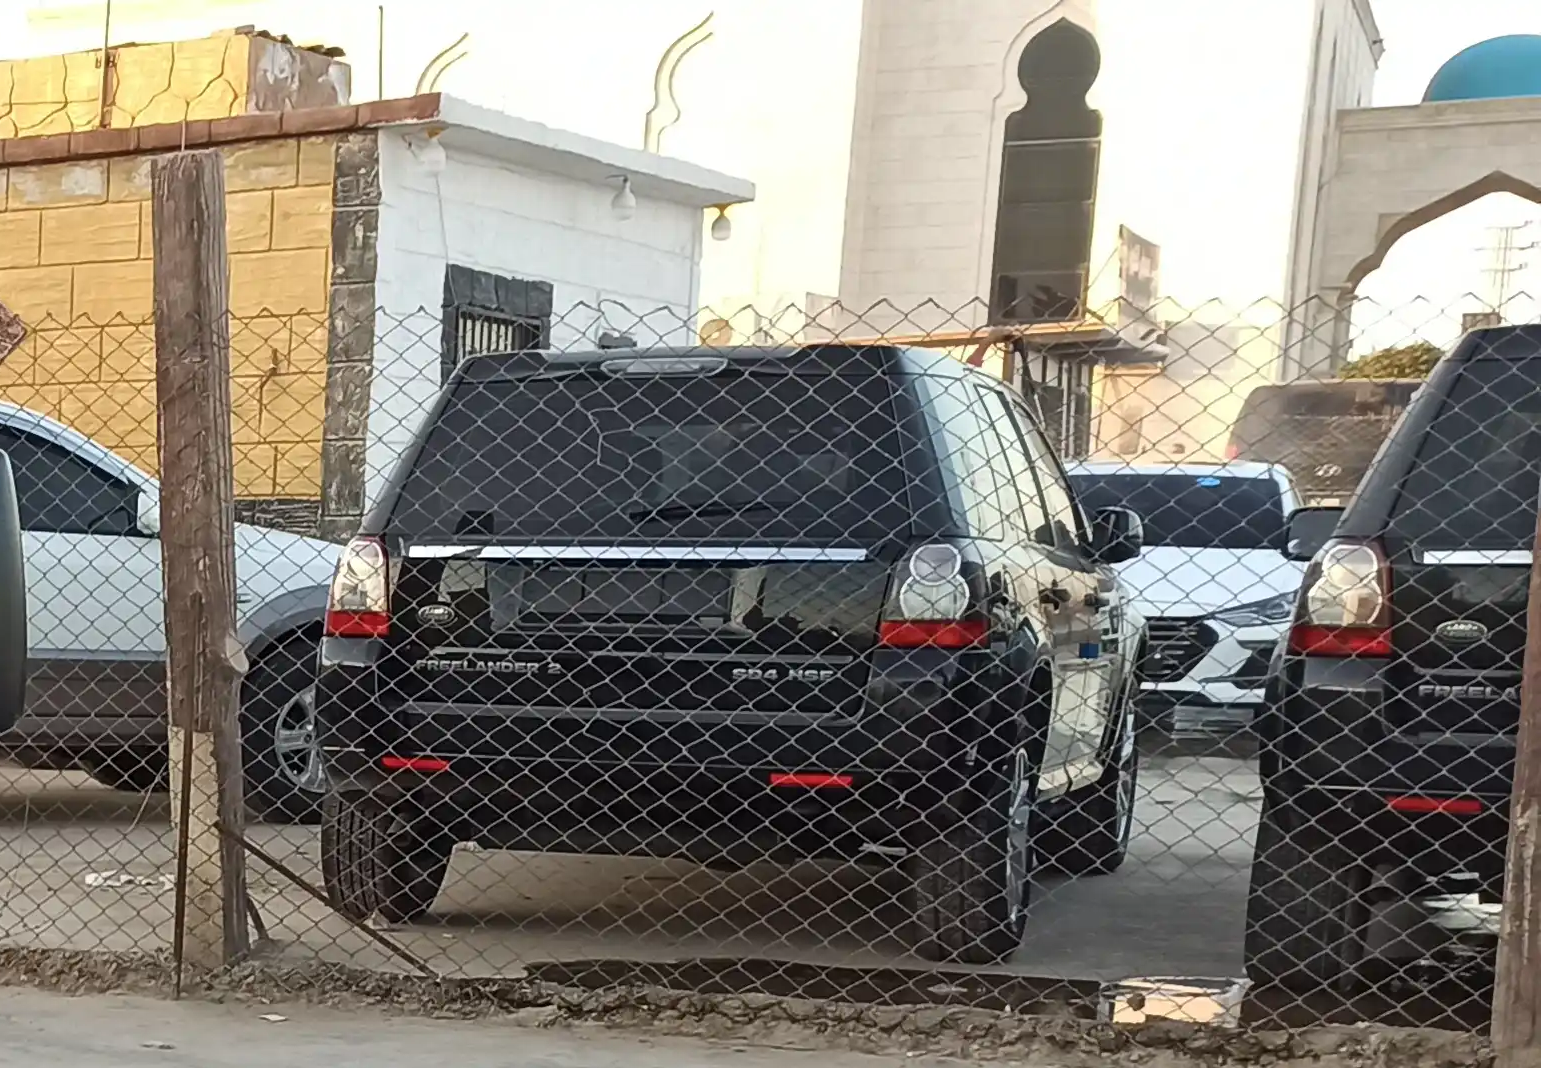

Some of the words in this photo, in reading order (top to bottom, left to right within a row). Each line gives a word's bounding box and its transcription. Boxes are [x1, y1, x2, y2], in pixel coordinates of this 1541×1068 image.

[416, 659, 539, 674] FREELANDER
[547, 662, 562, 675] 2
[732, 667, 779, 681] SD4
[788, 668, 834, 681] HSE
[1418, 684, 1521, 700] FREELA
